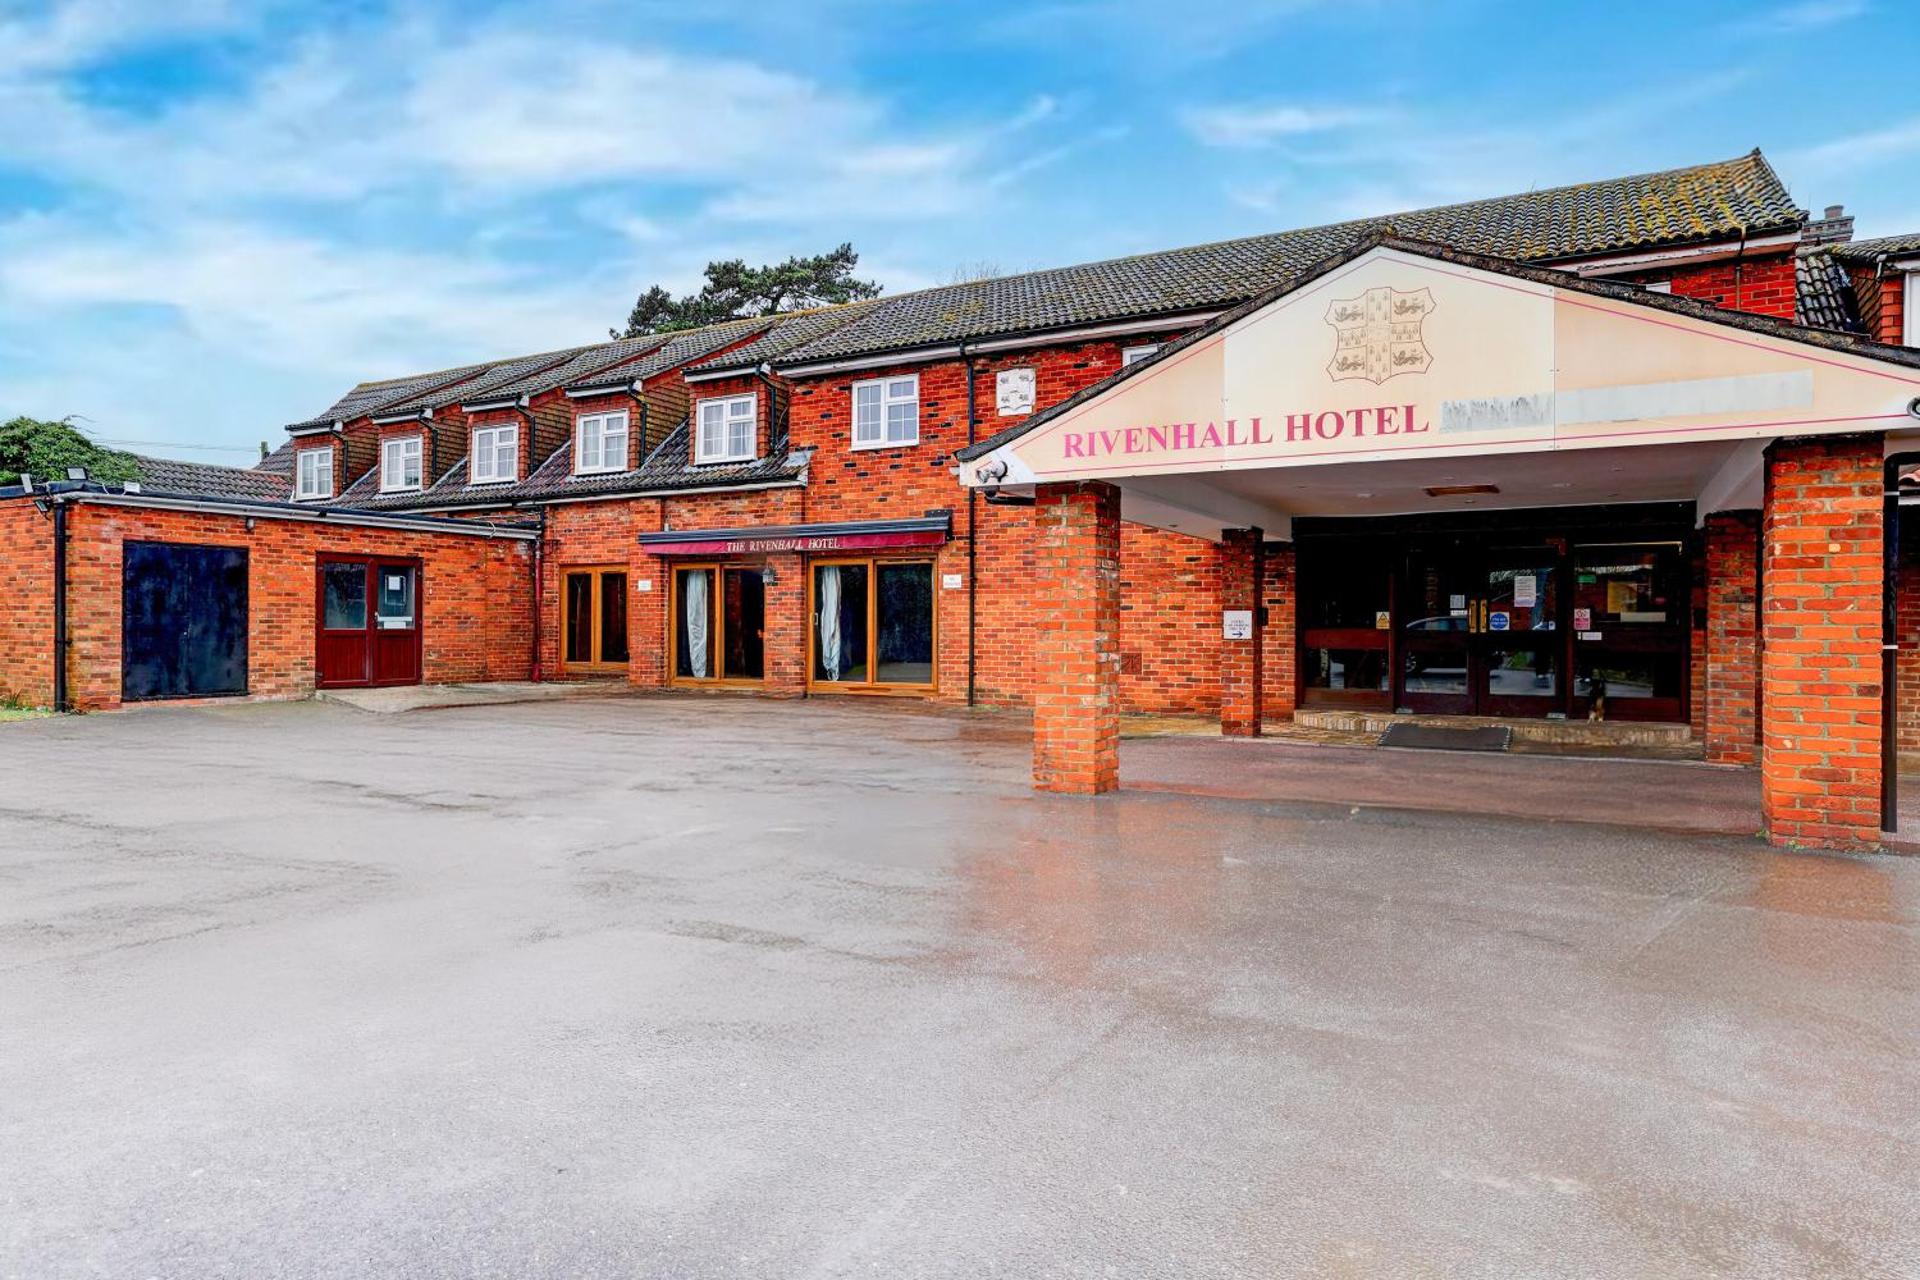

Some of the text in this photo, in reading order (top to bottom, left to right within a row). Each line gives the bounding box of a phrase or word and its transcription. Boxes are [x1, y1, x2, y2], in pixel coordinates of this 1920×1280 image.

[1064, 404, 1430, 458] RIVENHALL HOTEL
[726, 537, 841, 553] THE RIVENHALL HOTEL
